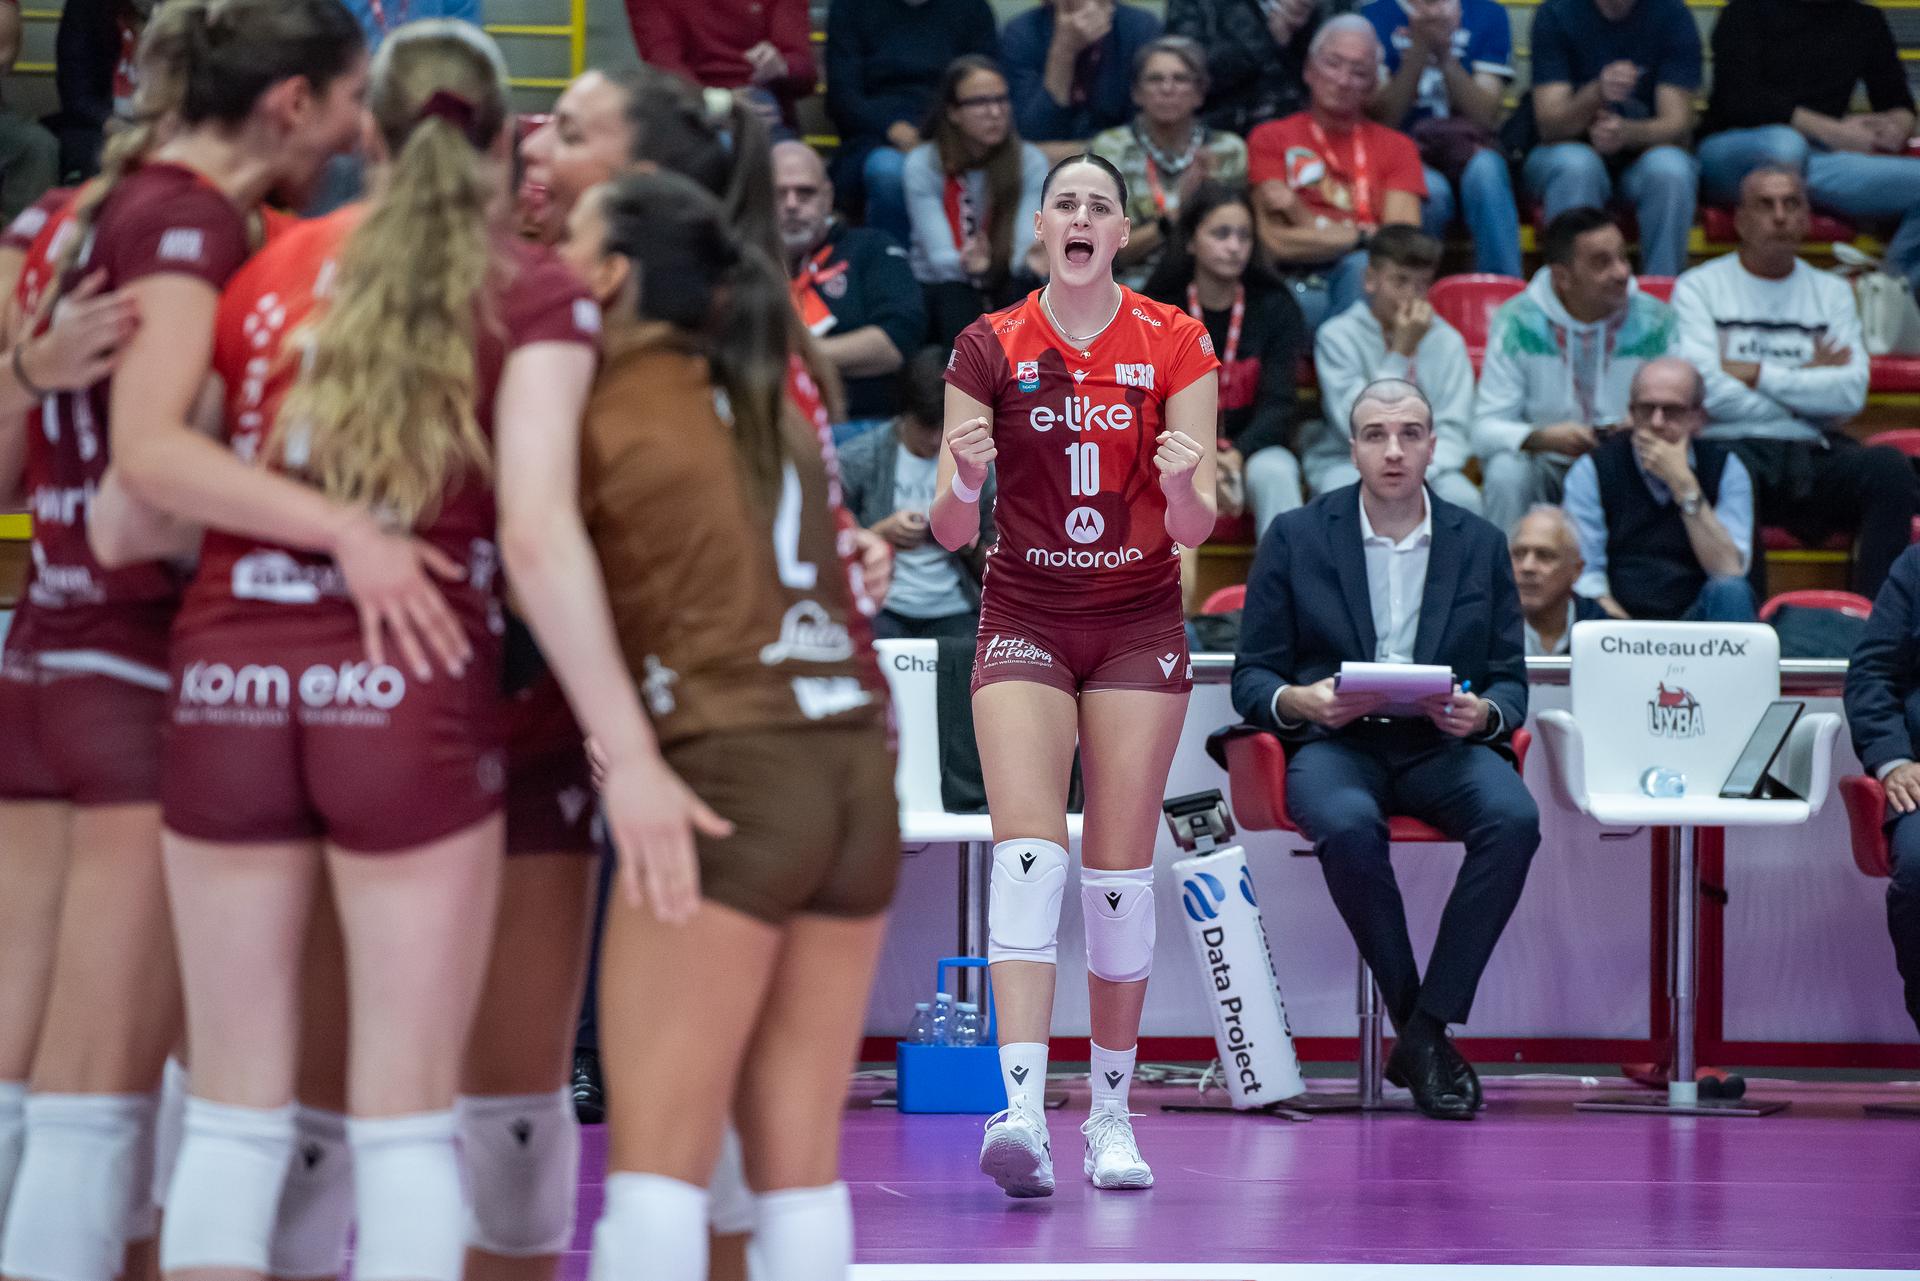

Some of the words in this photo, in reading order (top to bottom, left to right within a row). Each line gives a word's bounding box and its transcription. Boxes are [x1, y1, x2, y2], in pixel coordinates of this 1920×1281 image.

[1065, 442, 1100, 496] 10
[1026, 547, 1143, 569] motorola
[1600, 636, 1696, 656] Chateau
[1699, 639, 1746, 656] d'Ax
[1665, 664, 1687, 678] for
[1648, 701, 1705, 738] UYBA
[1202, 926, 1231, 992] Data
[1220, 996, 1262, 1096] Project
